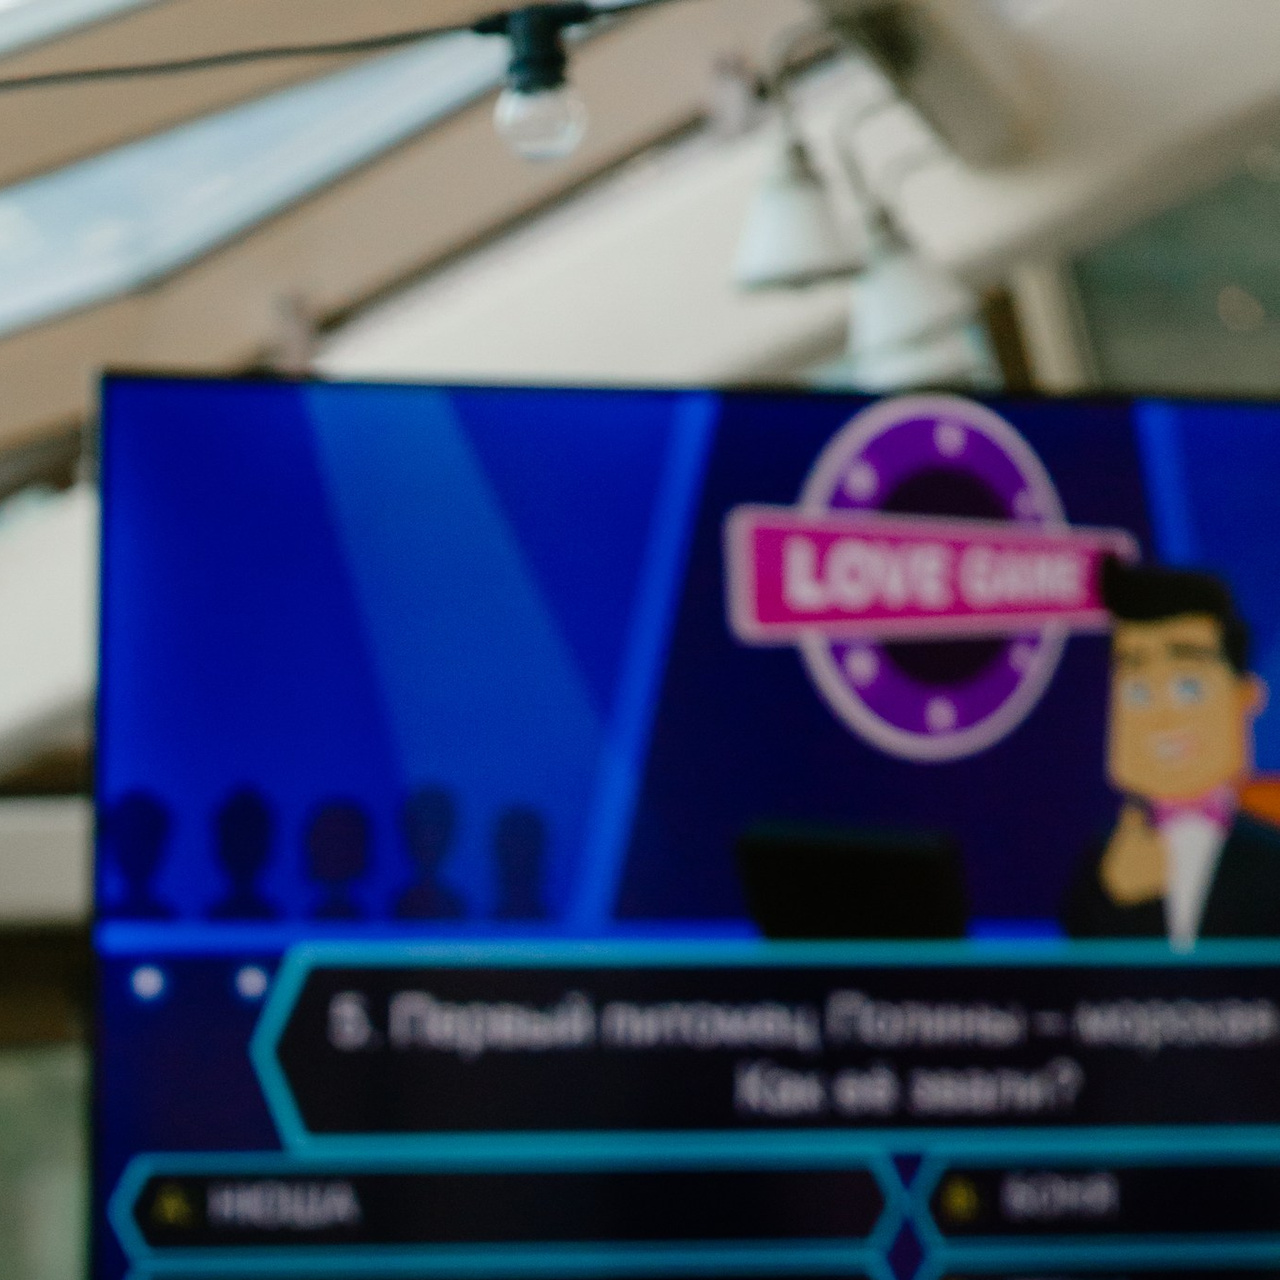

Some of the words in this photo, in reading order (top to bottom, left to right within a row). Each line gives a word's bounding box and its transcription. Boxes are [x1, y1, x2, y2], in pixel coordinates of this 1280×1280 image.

[783, 533, 954, 612] LOVE
[958, 545, 1084, 610] GAME
[388, 990, 597, 1061] Первый
[733, 1059, 823, 1117] Как
